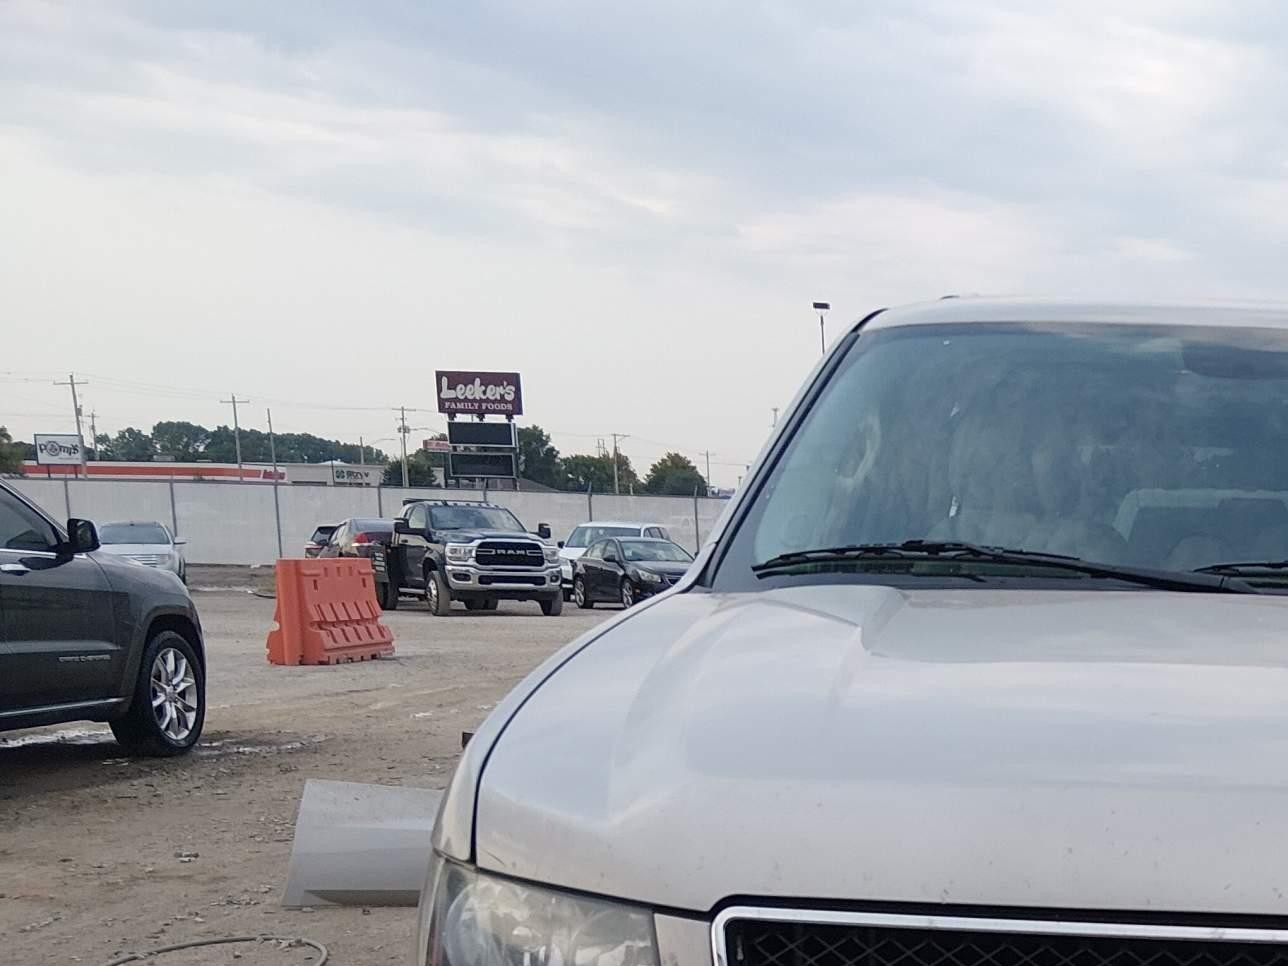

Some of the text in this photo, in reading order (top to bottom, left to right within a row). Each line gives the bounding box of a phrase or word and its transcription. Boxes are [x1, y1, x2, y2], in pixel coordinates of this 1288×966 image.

[440, 376, 516, 401] Leeker's
[444, 401, 513, 411] FAMILY FOODS
